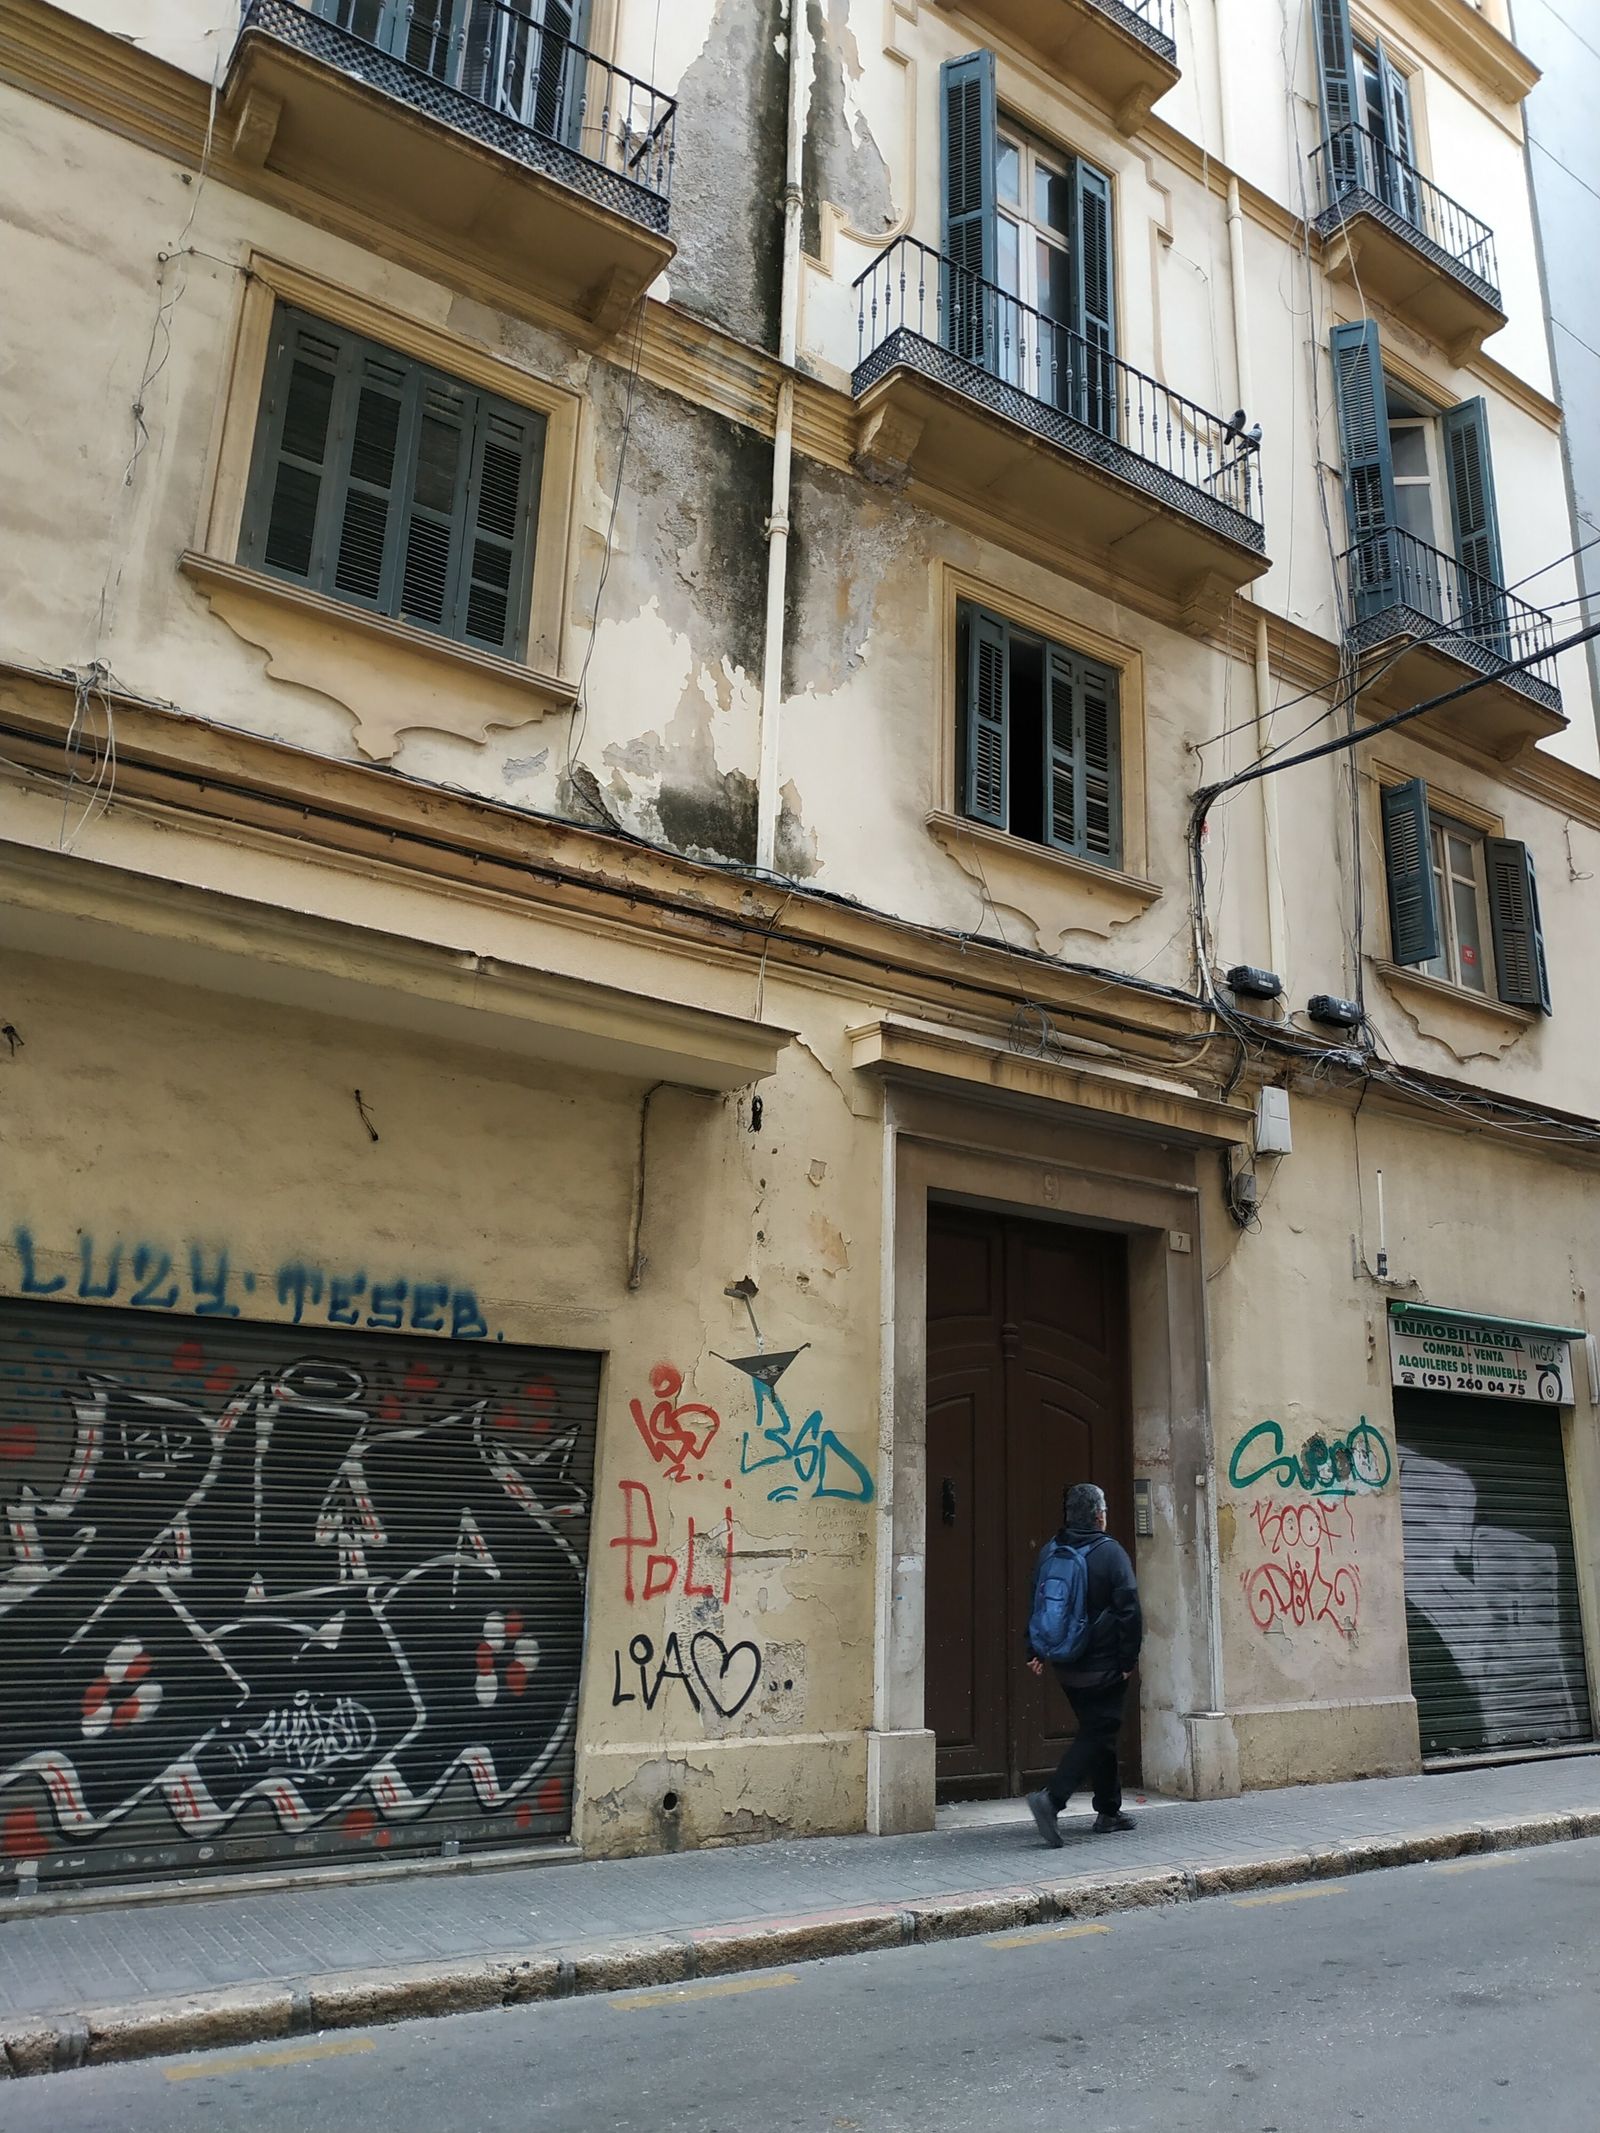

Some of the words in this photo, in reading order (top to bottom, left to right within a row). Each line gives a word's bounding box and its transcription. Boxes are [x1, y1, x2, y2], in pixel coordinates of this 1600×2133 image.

[1394, 1320, 1523, 1348] INMOBILIARIA
[1423, 1342, 1464, 1357] COMPRA
[1474, 1348, 1504, 1362] VENTA
[1399, 1355, 1458, 1373] ALQUILERES
[1461, 1363, 1472, 1375] DE
[1476, 1364, 1527, 1380] INMUEBLES
[1422, 1373, 1451, 1389] (95)
[1457, 1378, 1483, 1391] 260
[1488, 1381, 1504, 1393] 04
[1509, 1383, 1525, 1395] 75
